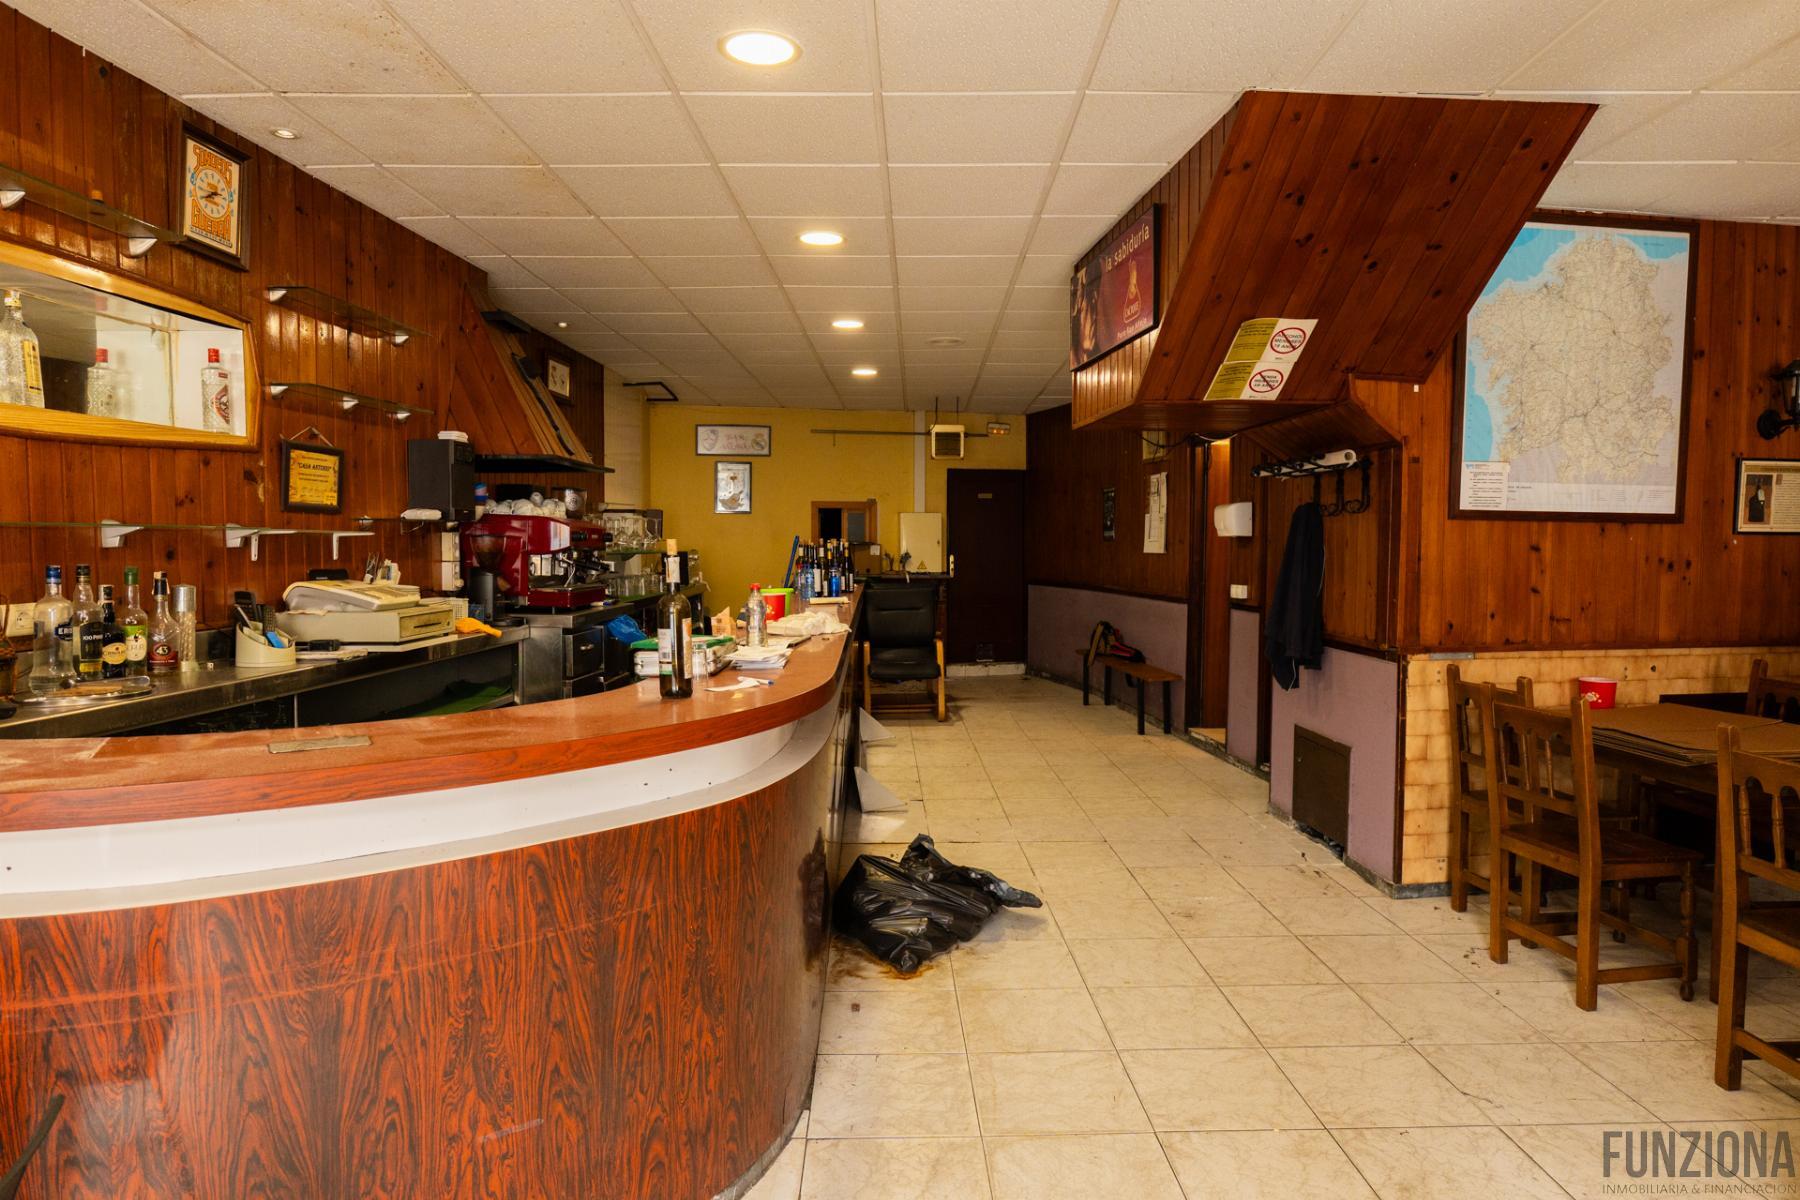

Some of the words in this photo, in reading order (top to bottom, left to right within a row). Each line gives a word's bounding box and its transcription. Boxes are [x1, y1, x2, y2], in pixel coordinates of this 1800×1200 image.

[1105, 256, 1113, 272] la
[1114, 223, 1150, 265] sabiduría
[155, 645, 169, 654] 43
